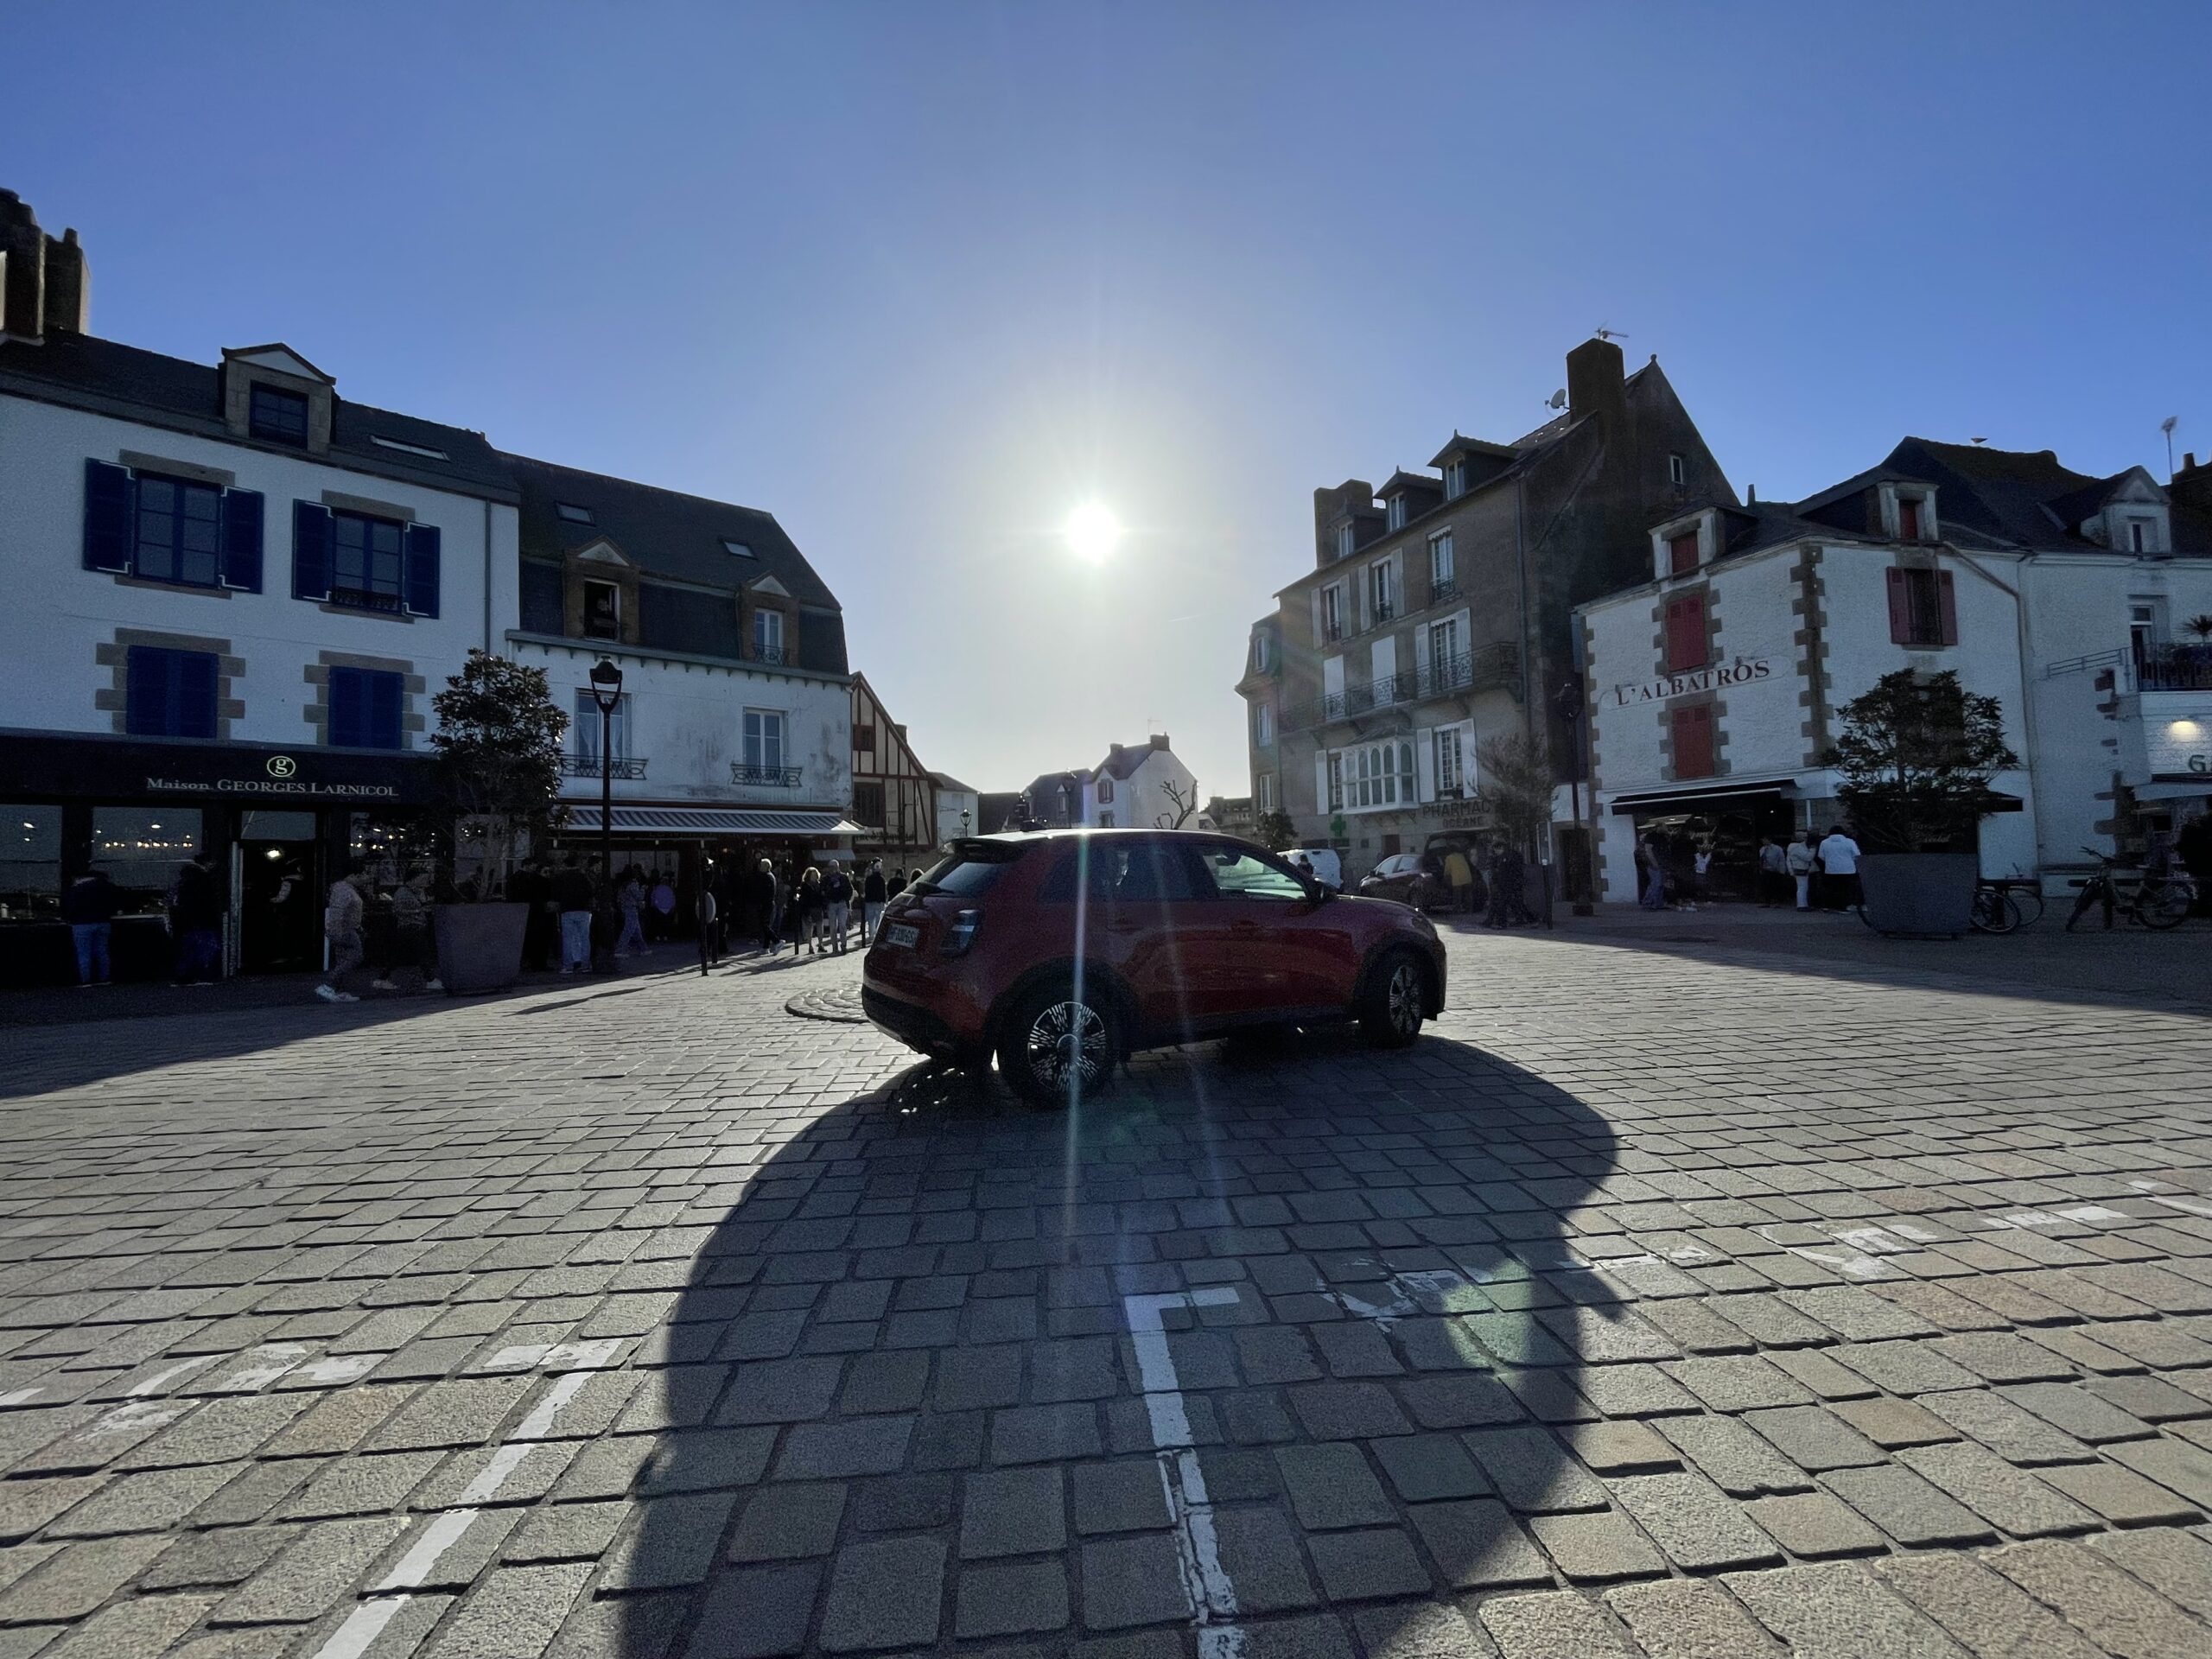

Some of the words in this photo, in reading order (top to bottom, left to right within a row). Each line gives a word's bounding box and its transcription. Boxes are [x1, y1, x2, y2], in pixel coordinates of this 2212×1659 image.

[1617, 660, 1770, 705] L'ALBATROS
[147, 778, 209, 791] Maison
[217, 779, 305, 793] GEORGES
[311, 782, 398, 796] LARNICOL
